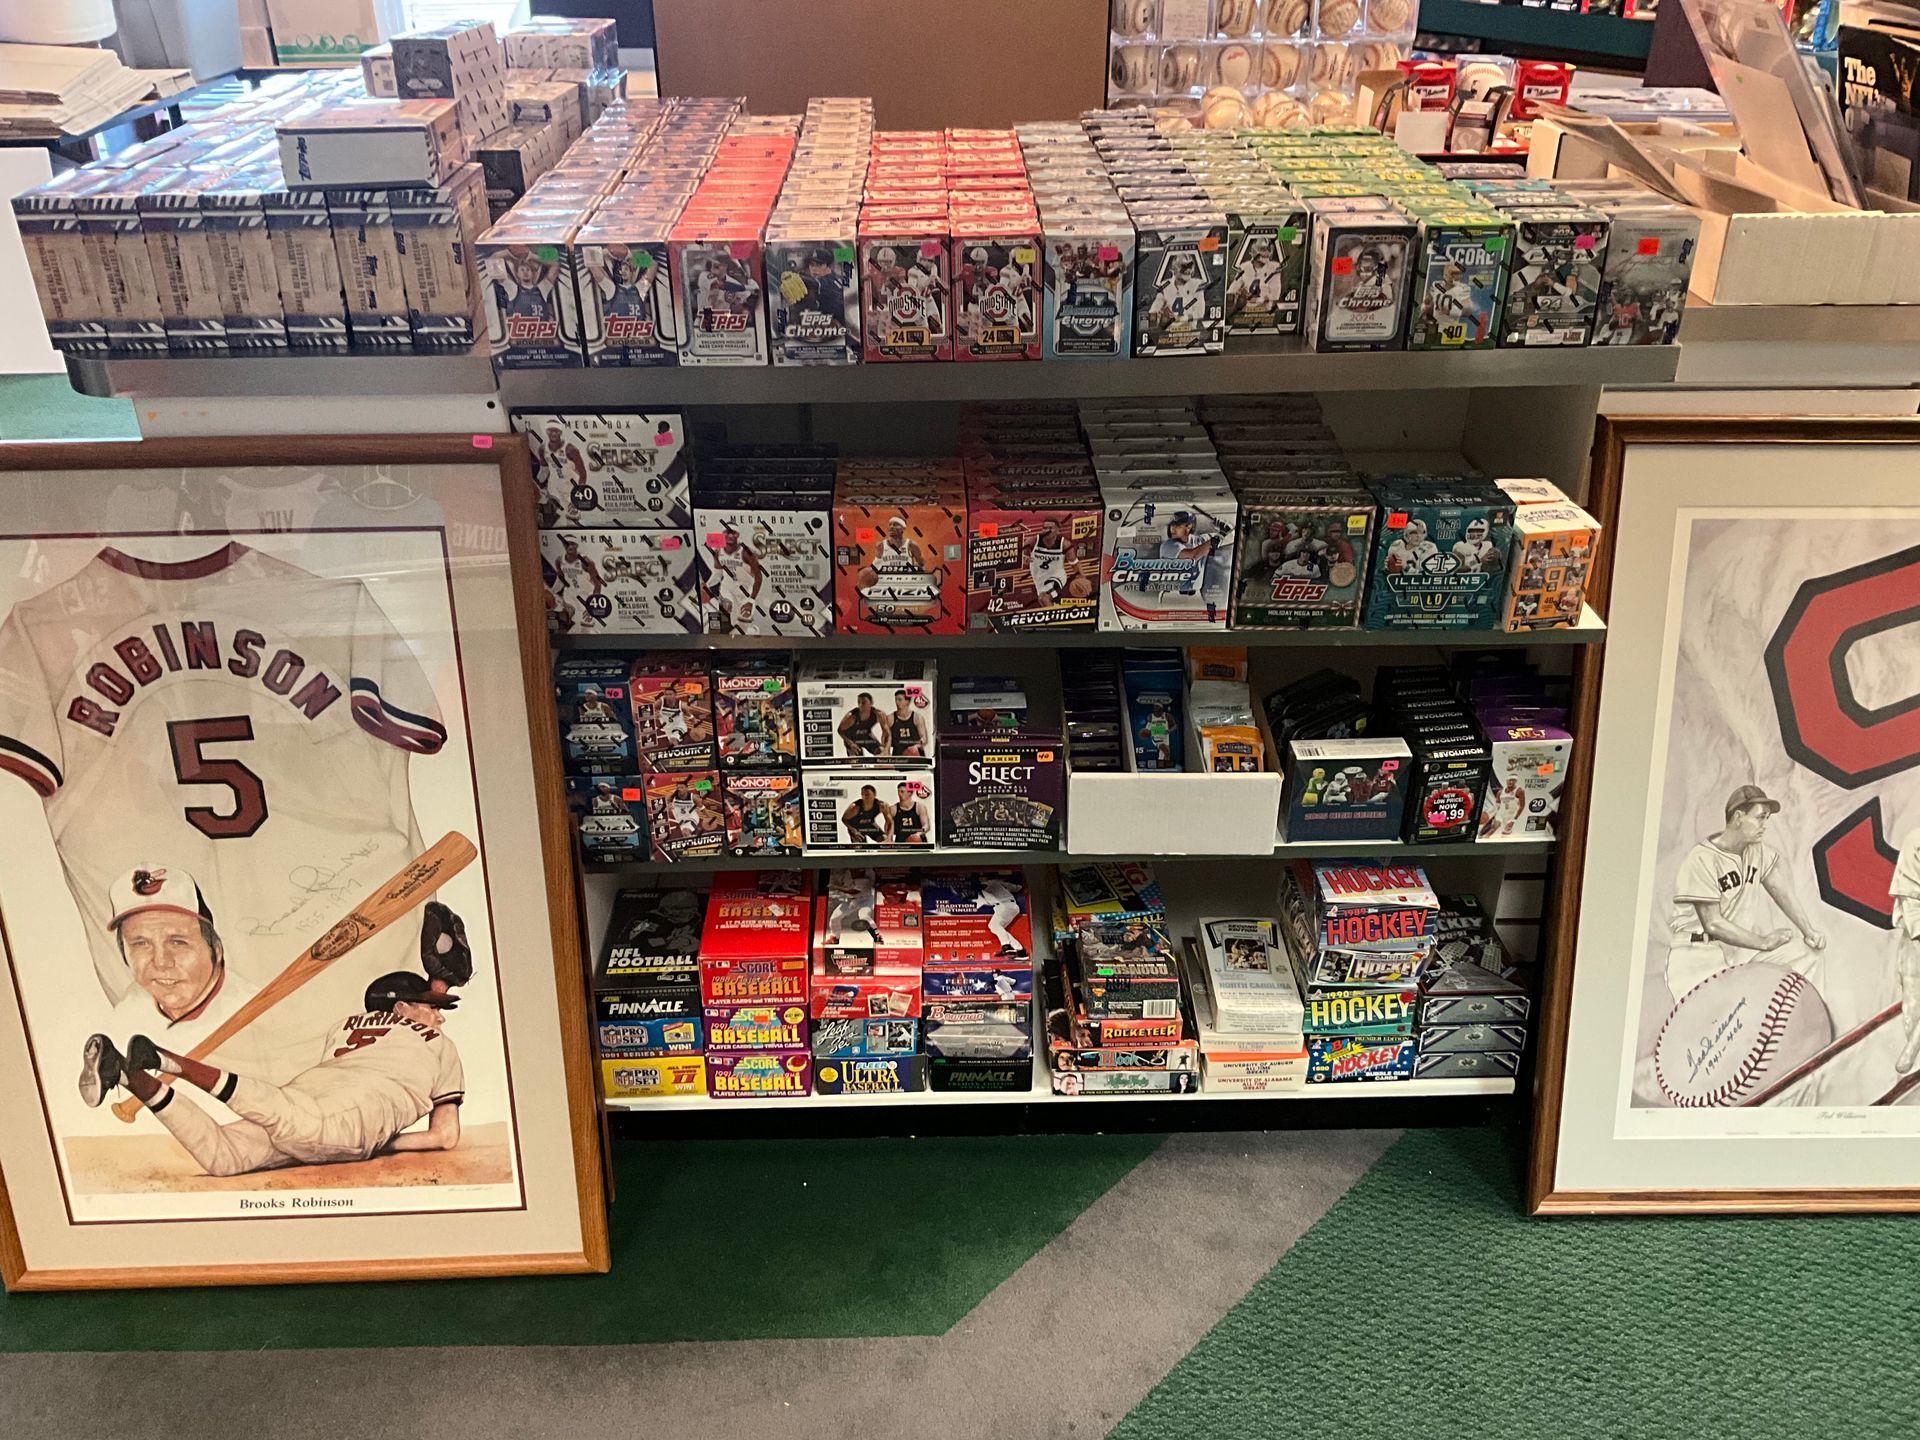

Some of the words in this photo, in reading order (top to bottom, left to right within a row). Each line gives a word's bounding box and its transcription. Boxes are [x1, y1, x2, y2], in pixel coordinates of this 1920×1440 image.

[1844, 57, 1876, 86] The
[531, 305, 542, 315] 32
[629, 304, 640, 315] 32
[1338, 299, 1392, 309] Chrome
[1541, 300, 1562, 309] 24
[785, 325, 847, 338] Chrome
[892, 331, 905, 343] 24
[983, 331, 995, 343] 24
[565, 420, 598, 429] MEGA
[607, 420, 631, 429] BOX
[574, 488, 592, 501] 40
[730, 516, 762, 524] MEGA
[771, 516, 793, 524] BOX
[1074, 526, 1096, 535] BOX
[973, 543, 1018, 554] ULTRA-RARE
[973, 549, 1018, 561] KABOOM
[1112, 547, 1194, 571] Bowman
[1112, 570, 1192, 582] Chome
[1000, 578, 1006, 588] 6
[590, 598, 607, 608] 40
[773, 603, 790, 614] 40
[877, 604, 895, 614] 50
[987, 598, 1004, 613] 42
[1011, 607, 1091, 626] REVOLUTION
[67, 621, 343, 737] ROBINSON
[806, 710, 813, 719] 4
[1414, 711, 1463, 720] REVOLUTION
[806, 723, 818, 732] 10
[900, 728, 911, 737] 21
[1419, 724, 1469, 732] REVOLUTION
[806, 736, 813, 744] 8
[1425, 734, 1475, 745] REVOLUTION
[1433, 747, 1484, 759] REVOLUTION
[167, 715, 268, 839] 5
[968, 762, 1035, 785] SELECT
[1428, 768, 1480, 782] REVOLUTION
[730, 777, 792, 789] MONOPY
[811, 812, 822, 820] 10
[902, 818, 913, 826] 21
[811, 823, 818, 831] 8
[671, 835, 722, 850] REVOLUTION
[1322, 866, 1425, 895] HOCKEY
[1717, 870, 1741, 892] ED
[1327, 909, 1429, 946] HOCKEY
[611, 948, 641, 958] NFL
[608, 955, 693, 967] FOOTBALL
[731, 961, 776, 973] SCORE
[1354, 958, 1422, 977] HOCKEY
[712, 975, 731, 983] 1988
[712, 982, 801, 996] BASEBALL
[609, 998, 684, 1015] PINNACLE
[1311, 993, 1410, 1028] HOCKEY
[927, 1006, 984, 1021] Bowman
[623, 1028, 645, 1036] PRO
[711, 1030, 801, 1044] BASEBALL
[334, 1027, 391, 1057] 5
[623, 1036, 645, 1044] SET
[735, 1057, 780, 1069] SCORE
[856, 1062, 888, 1070] FLEER
[1333, 1045, 1402, 1077] HOCKEY
[634, 1069, 657, 1077] PRO
[840, 1061, 900, 1084] ULTRA
[950, 1069, 1014, 1081] PINNACLE
[635, 1077, 658, 1086] SET
[715, 1077, 803, 1091] BASEBALL
[843, 1082, 900, 1092] BASEBALL
[1835, 1111, 1867, 1120] Williams
[240, 1198, 285, 1209] Brooks
[291, 1197, 353, 1208] Robinson
